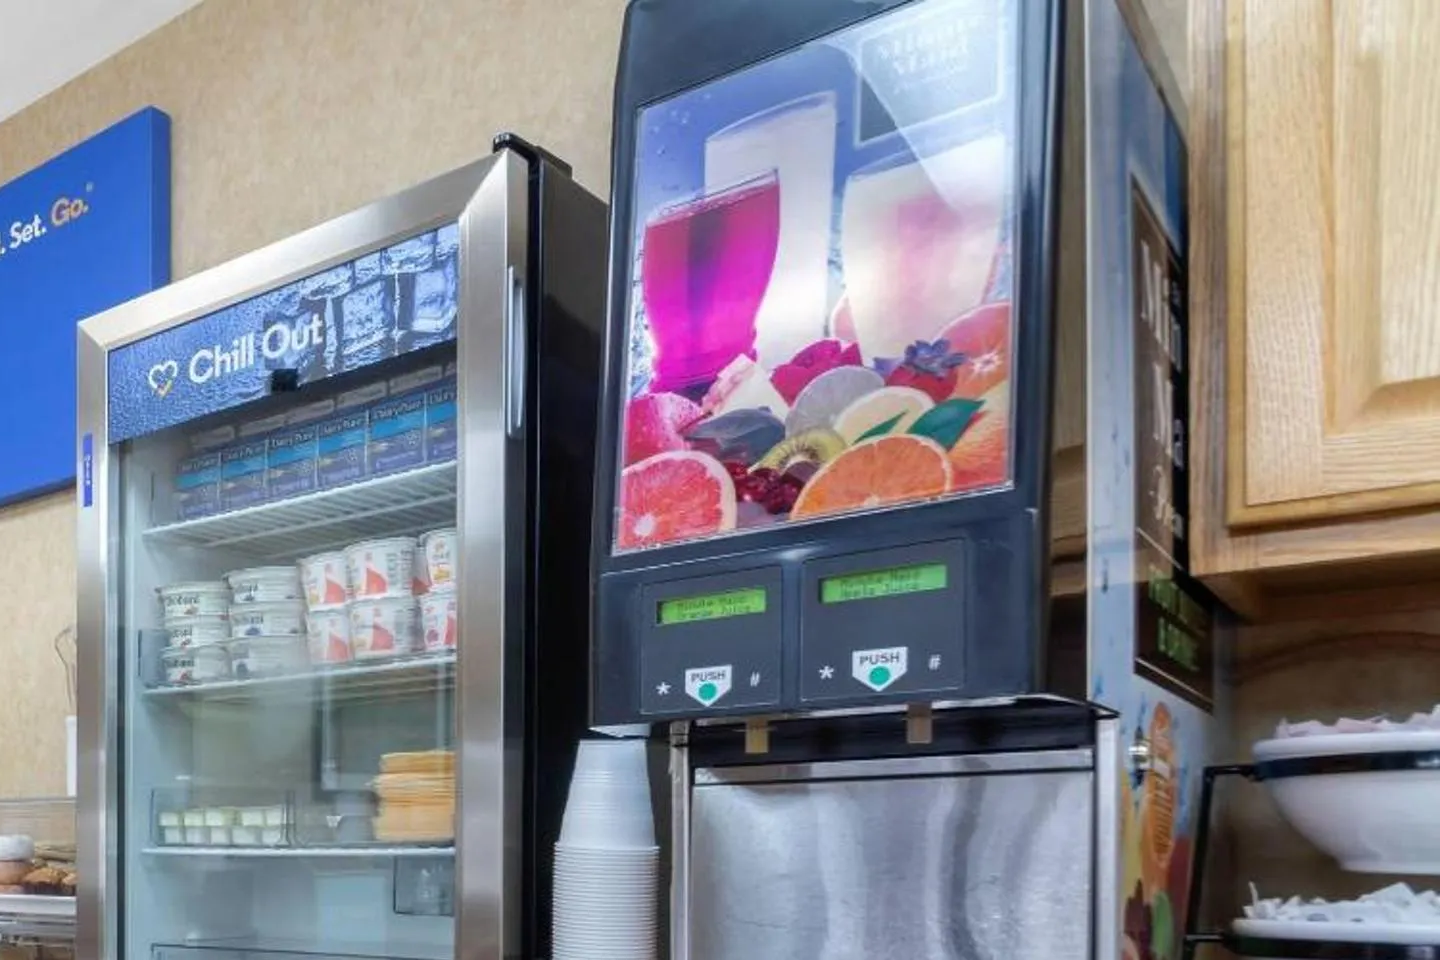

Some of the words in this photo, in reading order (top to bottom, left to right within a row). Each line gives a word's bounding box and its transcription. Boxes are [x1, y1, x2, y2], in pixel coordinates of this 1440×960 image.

[10, 214, 47, 249] Set.
[189, 331, 255, 384] Chill
[262, 313, 323, 359] Out
[859, 651, 901, 667] PUSH
[690, 669, 727, 683] PUSH
